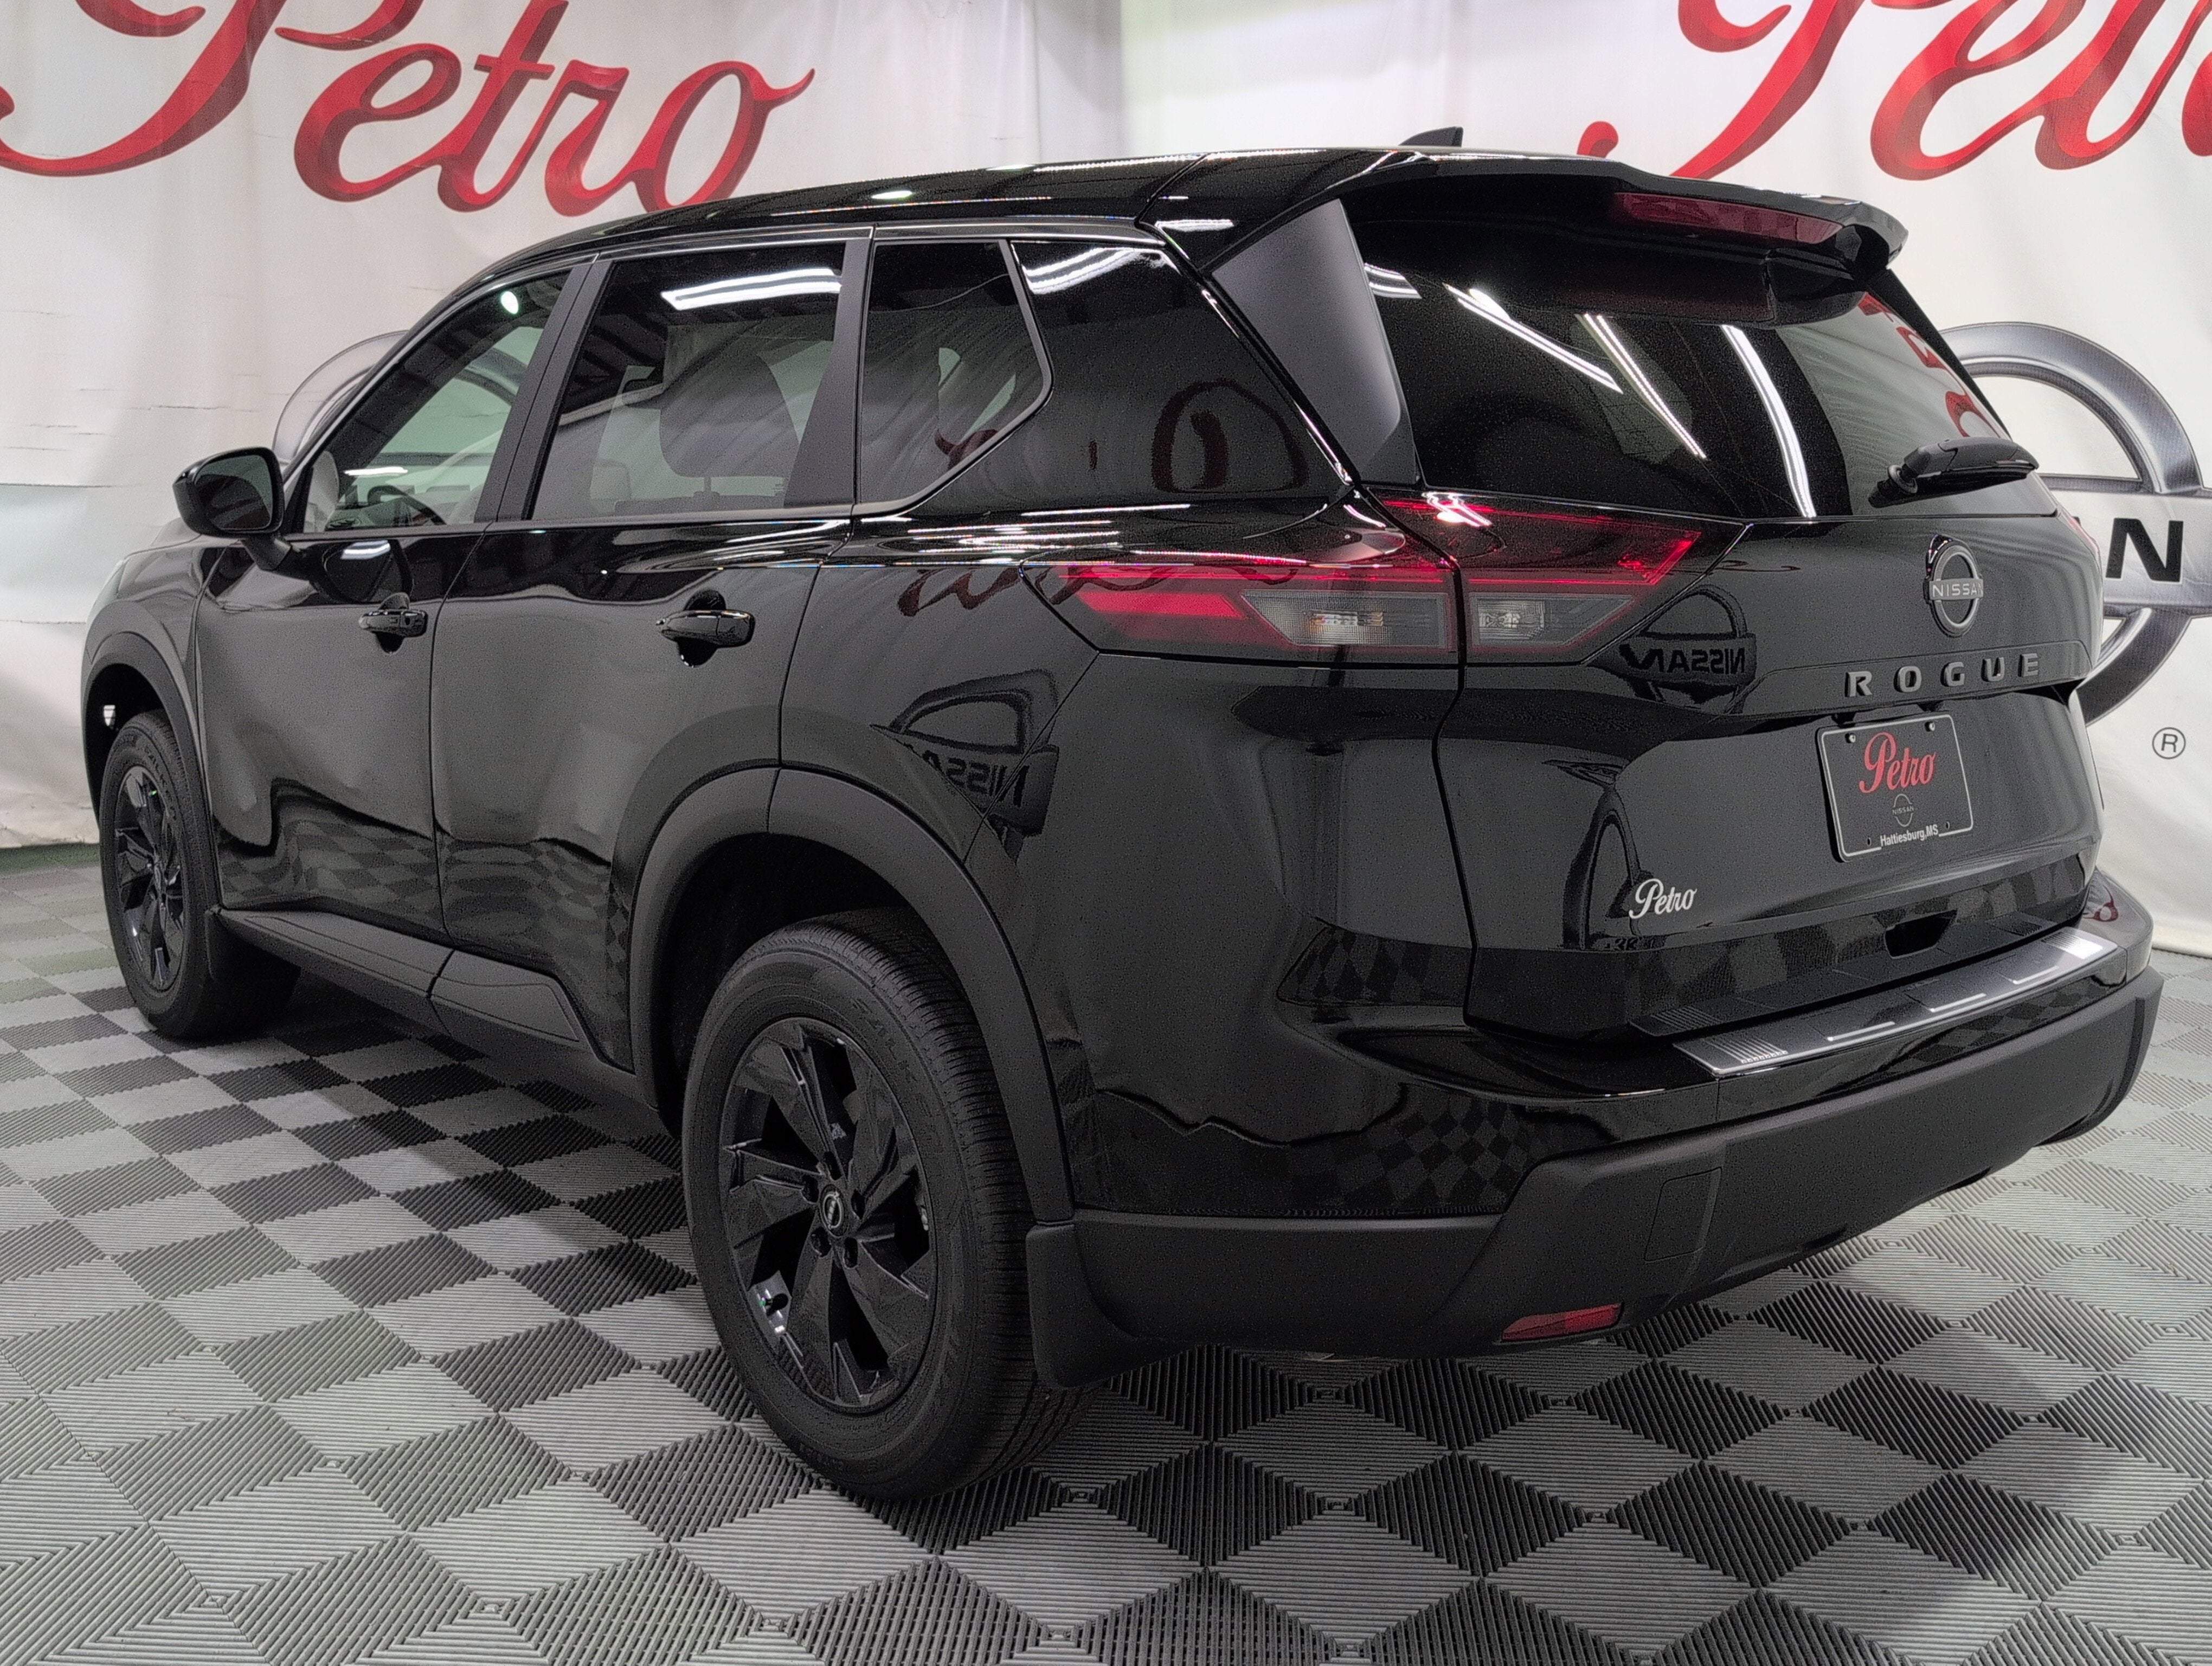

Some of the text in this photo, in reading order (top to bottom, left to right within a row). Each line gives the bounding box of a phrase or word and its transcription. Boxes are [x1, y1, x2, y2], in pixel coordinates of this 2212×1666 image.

[1932, 583, 1983, 597] NISSAN
[1845, 653, 2039, 697] ROGUE
[1859, 732, 1937, 793] Petro
[1892, 805, 1914, 815] NISSAN
[1629, 878, 1697, 919] Petro
